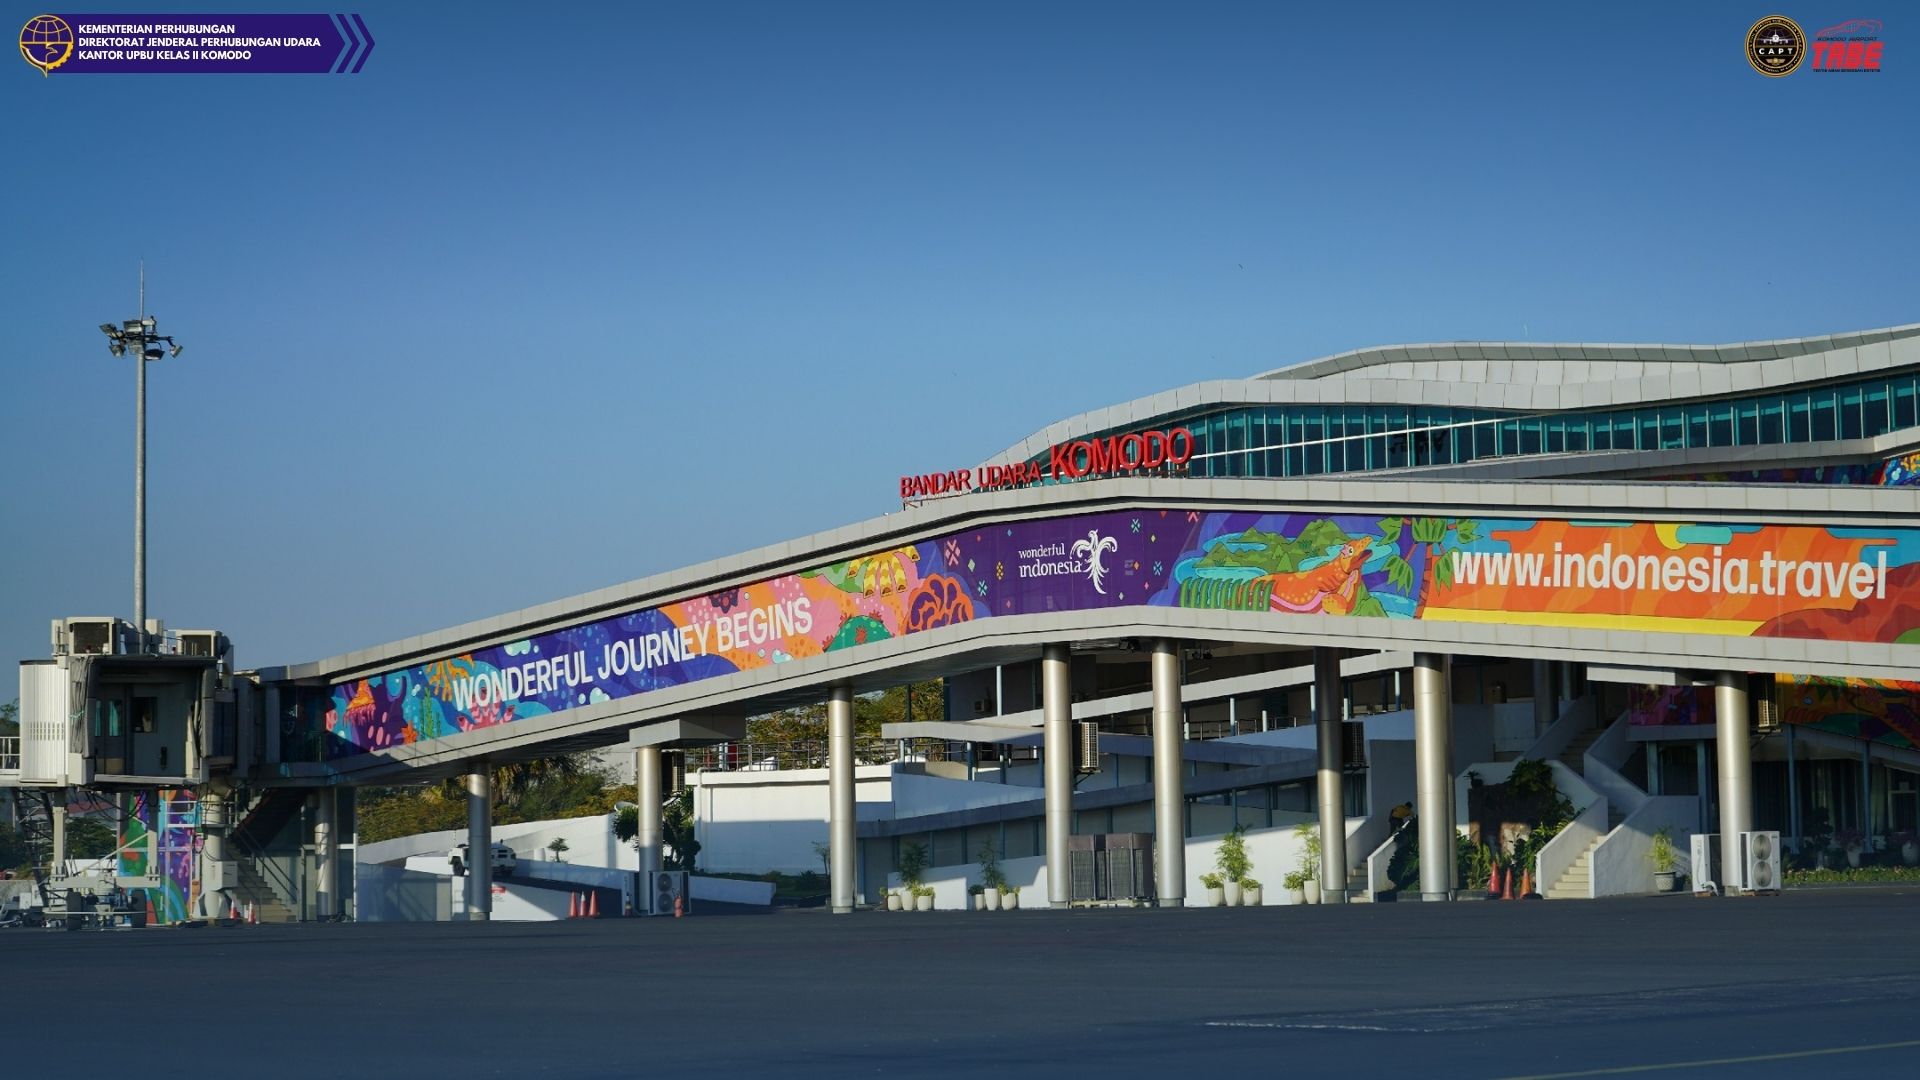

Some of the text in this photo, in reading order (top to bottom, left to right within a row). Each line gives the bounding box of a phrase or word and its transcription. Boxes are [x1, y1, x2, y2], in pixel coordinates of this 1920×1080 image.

[900, 427, 1196, 498] BANDAR UDARA KOMODO
[1018, 543, 1065, 559] wonderful
[1018, 559, 1083, 578] indonesia
[1451, 541, 1887, 600] www.indonesia.travel
[453, 597, 813, 712] WONDERFUL JOURNEY BEGINS
